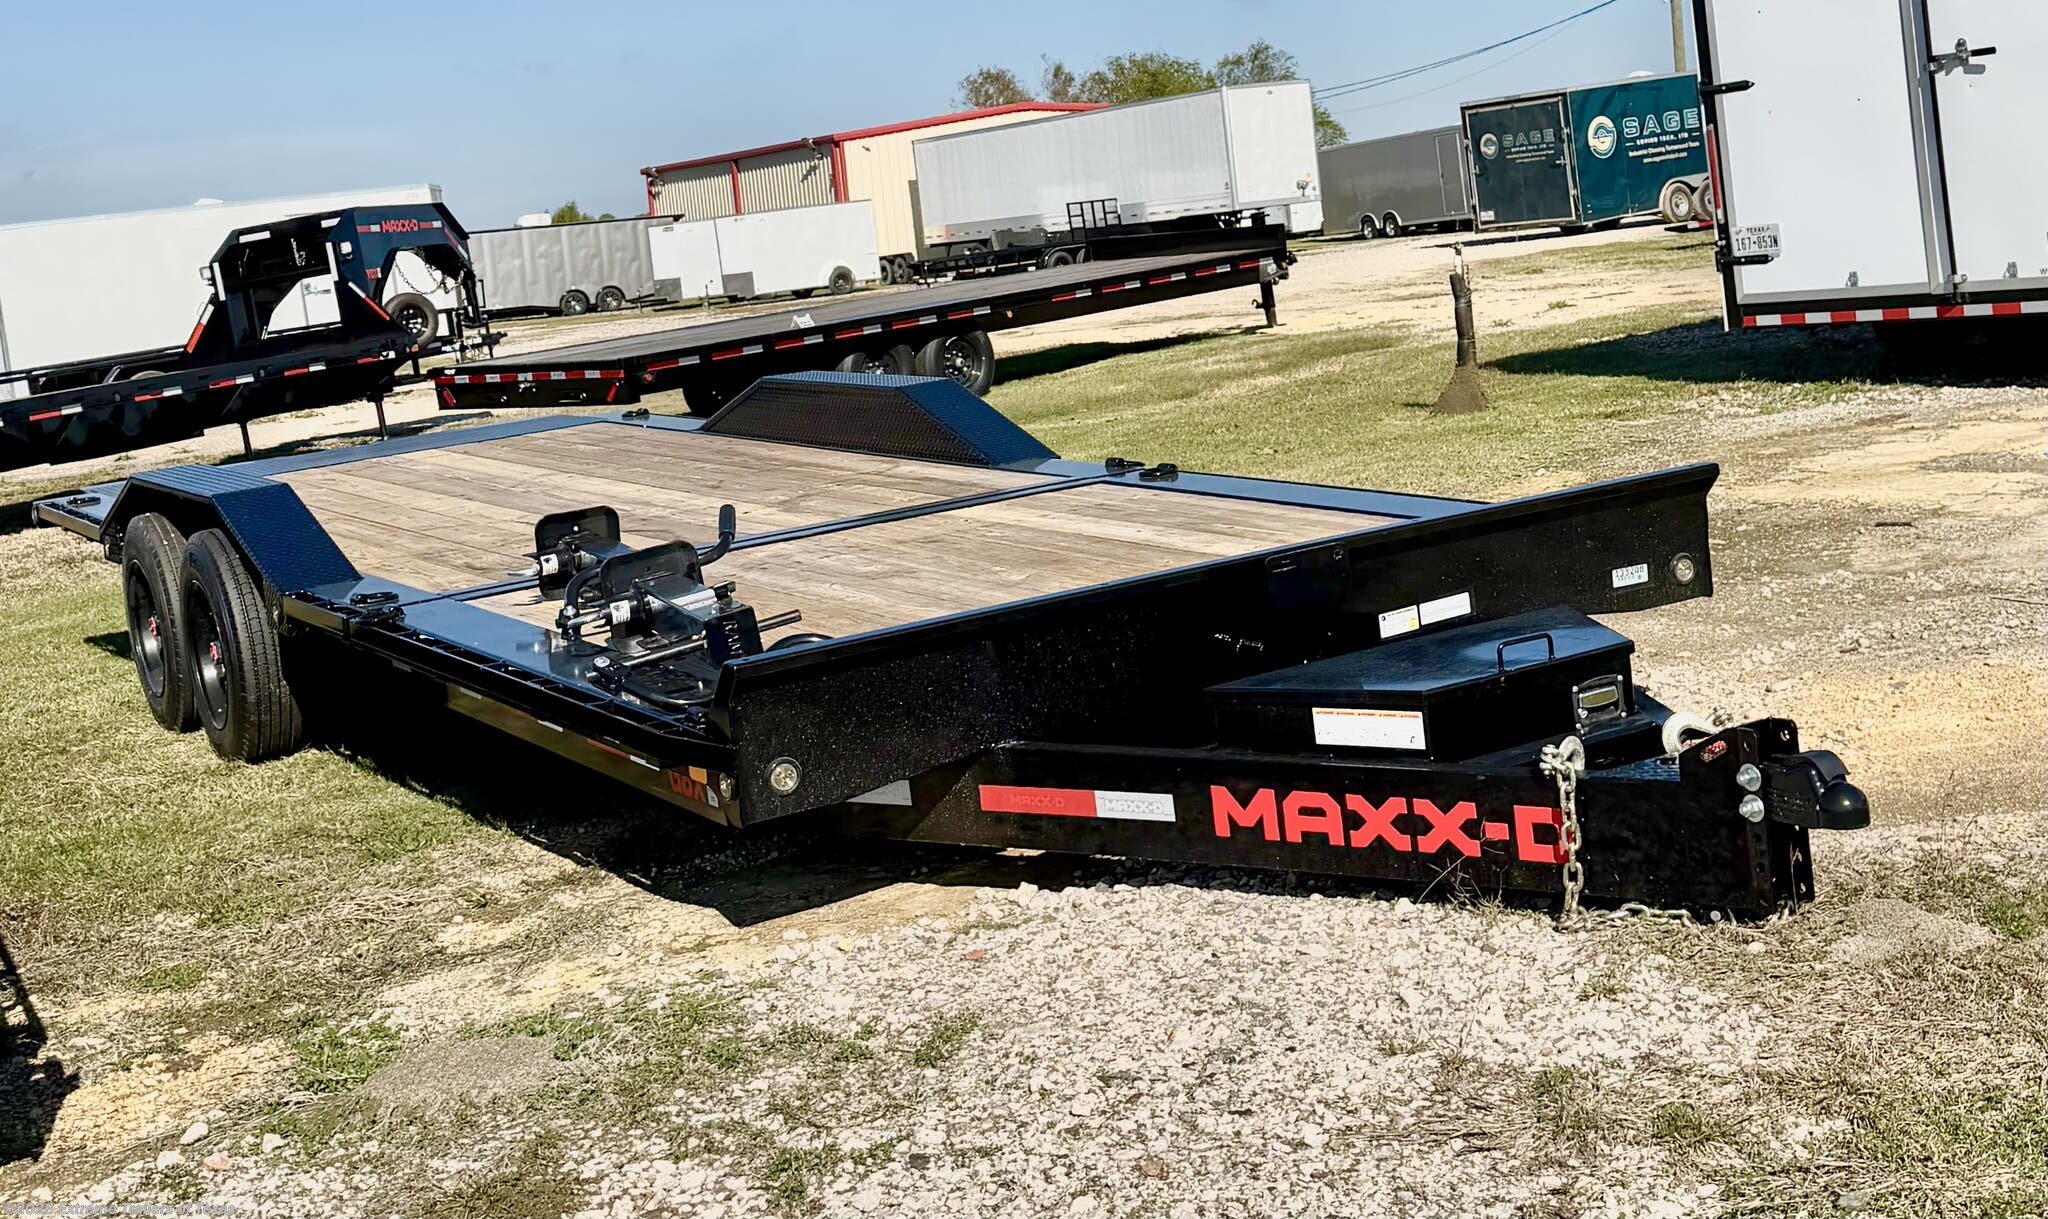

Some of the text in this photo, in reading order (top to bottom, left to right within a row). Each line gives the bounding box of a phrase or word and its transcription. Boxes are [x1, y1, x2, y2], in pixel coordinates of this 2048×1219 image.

[1622, 108, 1700, 138] SAGE
[1502, 128, 1555, 147] SAGE
[381, 219, 418, 232] MAXX-D
[1104, 799, 1165, 813] MAXX-D
[1210, 785, 1576, 863] MAXX-D
